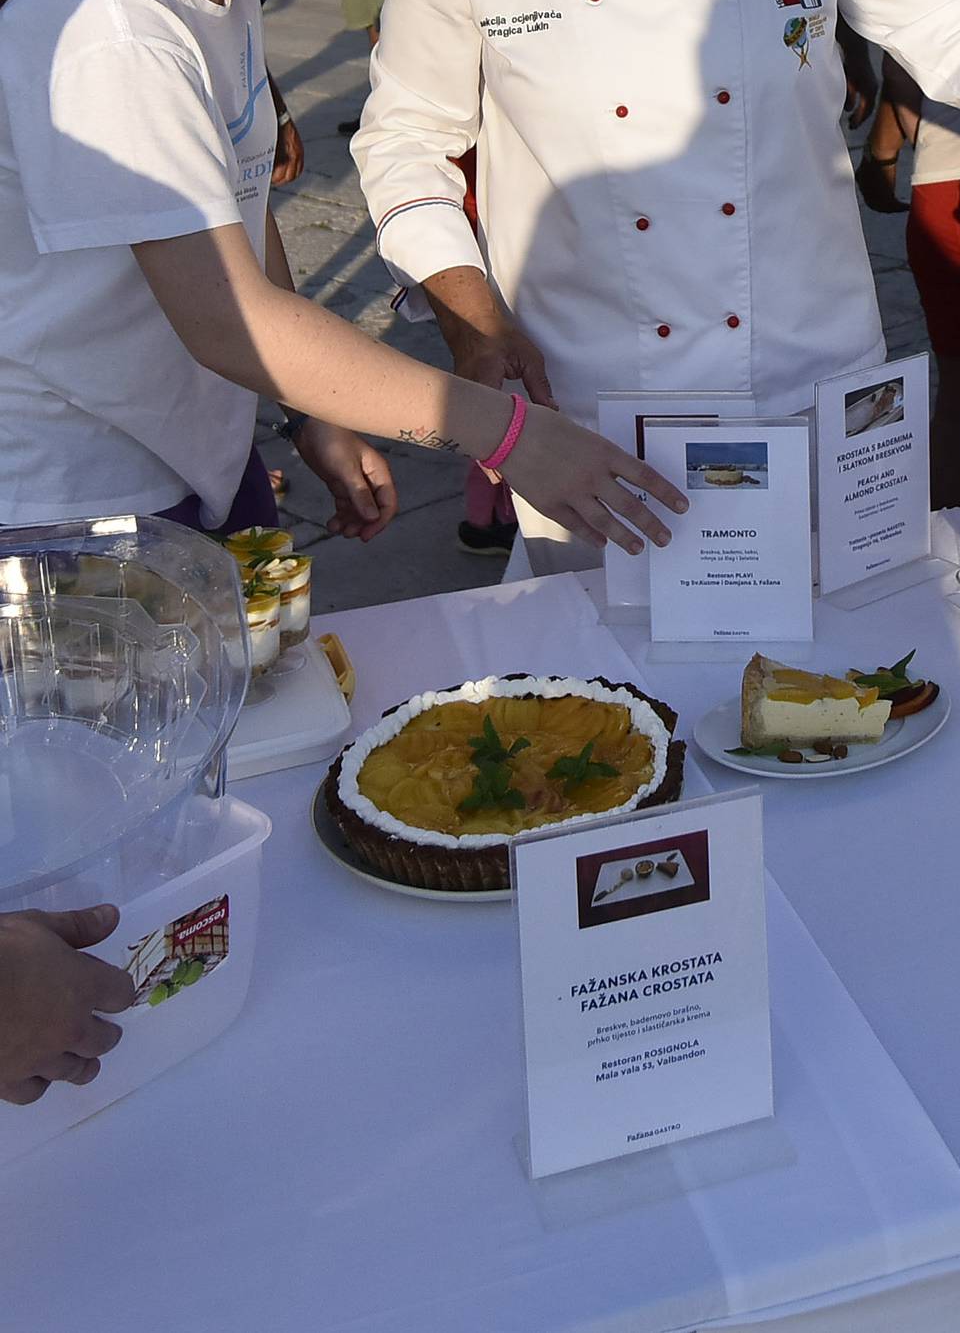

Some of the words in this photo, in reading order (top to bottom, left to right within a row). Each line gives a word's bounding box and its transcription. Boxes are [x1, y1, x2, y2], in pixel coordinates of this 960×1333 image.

[488, 27, 522, 38] Dragica
[527, 22, 549, 33] Lukin
[837, 447, 871, 463] KROSTATA
[877, 432, 913, 451] BADEMIMA
[843, 455, 875, 473] SLATKOM
[876, 443, 912, 462] BRESKVOM
[844, 487, 875, 503] ALMOND
[876, 475, 909, 493] CROSTATA
[858, 474, 880, 488] PEACH
[881, 469, 895, 481] AND
[701, 530, 758, 539] TRAMONTO
[571, 969, 648, 998] FAŽANSKA
[651, 952, 723, 979] KROSTATA
[581, 989, 639, 1013] FAŽANA
[643, 970, 715, 997] CROSTATA
[587, 1034, 611, 1049] prhko
[612, 1028, 636, 1043] tijesto
[642, 1016, 686, 1034] slastičarska
[687, 1010, 711, 1022] krema
[597, 1021, 629, 1035] Breskve,
[630, 1010, 672, 1027] bademovo
[673, 1004, 702, 1017] brašno,
[595, 1071, 619, 1083] Mala
[621, 1066, 641, 1077] vala
[657, 1049, 706, 1067] Valbandon
[601, 1054, 643, 1070] Restoran
[644, 1039, 700, 1060] ROSIGNOLA
